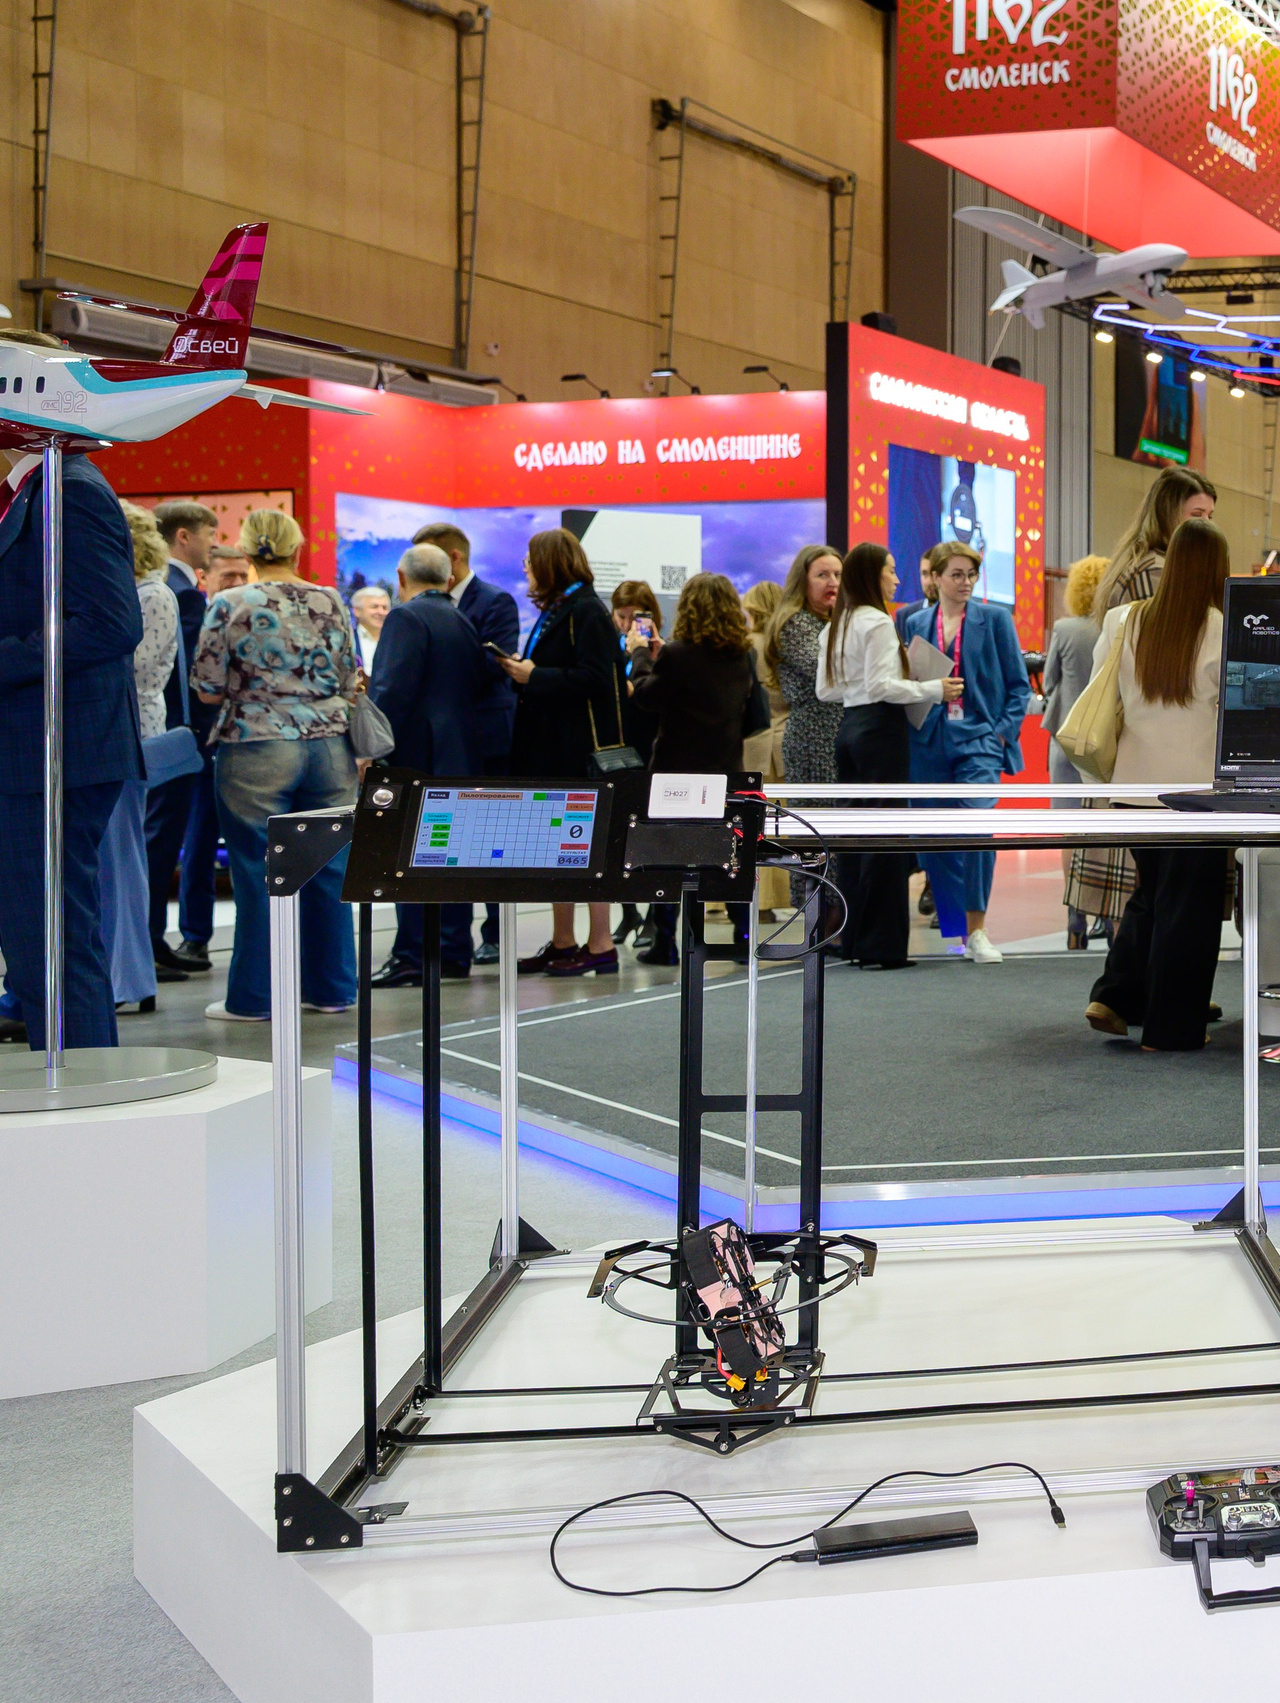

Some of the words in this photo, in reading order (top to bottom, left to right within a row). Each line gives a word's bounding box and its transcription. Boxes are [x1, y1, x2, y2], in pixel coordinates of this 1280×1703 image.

[945, 59, 1071, 92] СМОЛЕНСК
[1207, 43, 1258, 138] 1162
[174, 336, 239, 354] Освей
[57, 391, 88, 413] 192
[514, 440, 608, 472] СДЕЛАНО
[617, 439, 646, 465] НА
[656, 433, 802, 465] СМОЛЕНЩИНЕ
[569, 825, 583, 838] 0
[558, 857, 587, 865] 0465
